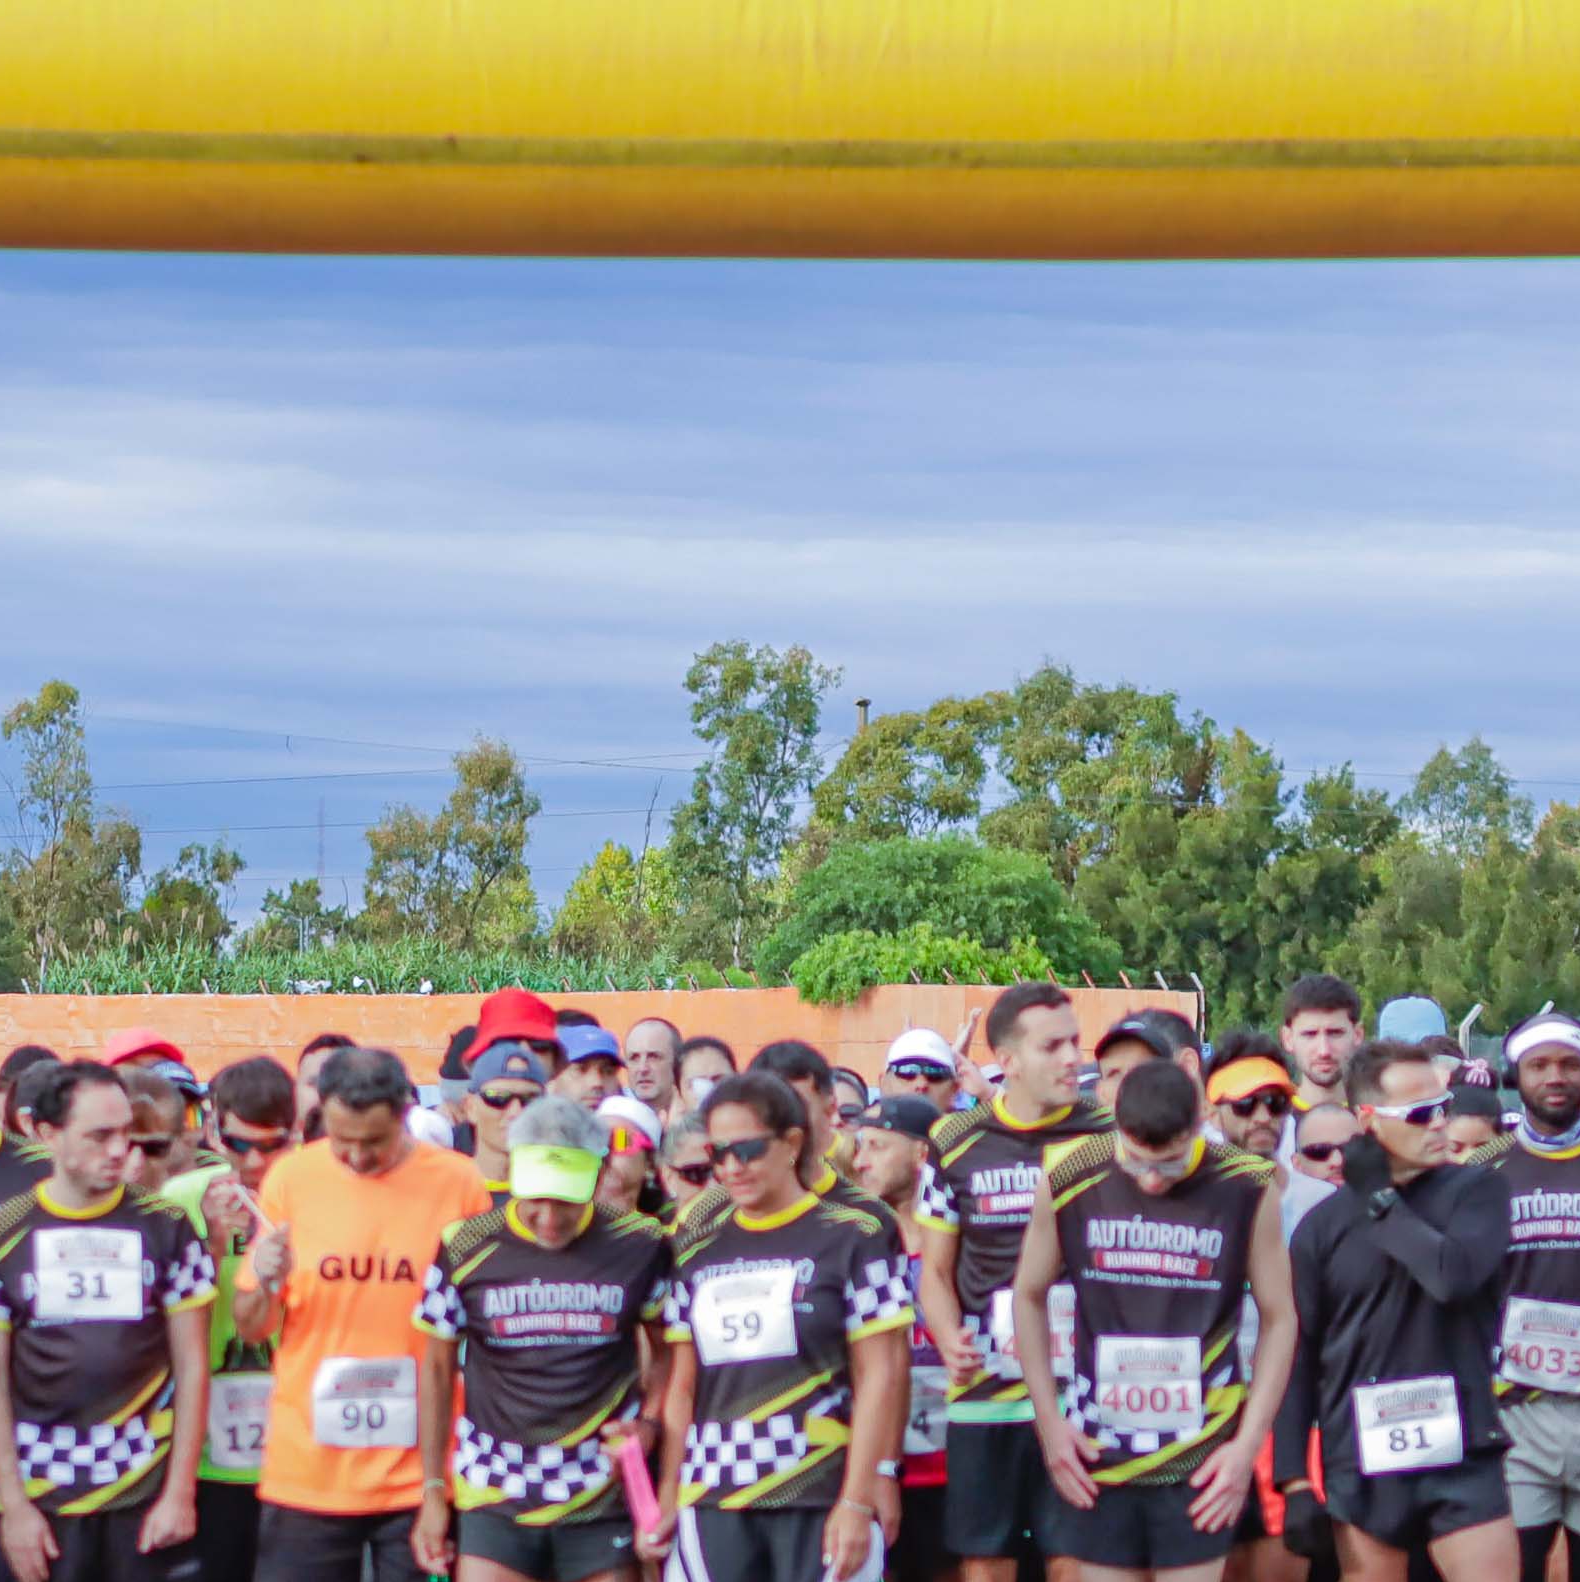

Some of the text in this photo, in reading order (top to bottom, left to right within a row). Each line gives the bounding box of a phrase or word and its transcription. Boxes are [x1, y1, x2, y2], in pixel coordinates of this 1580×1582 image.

[1087, 1214, 1223, 1259] AUTÓDROMO
[66, 1271, 112, 1300] 31
[484, 1278, 624, 1318] AUTÓDROMO
[722, 1311, 762, 1342] 59
[1102, 1383, 1193, 1413] 4001
[342, 1403, 387, 1431] 90
[1388, 1426, 1432, 1453] 81
